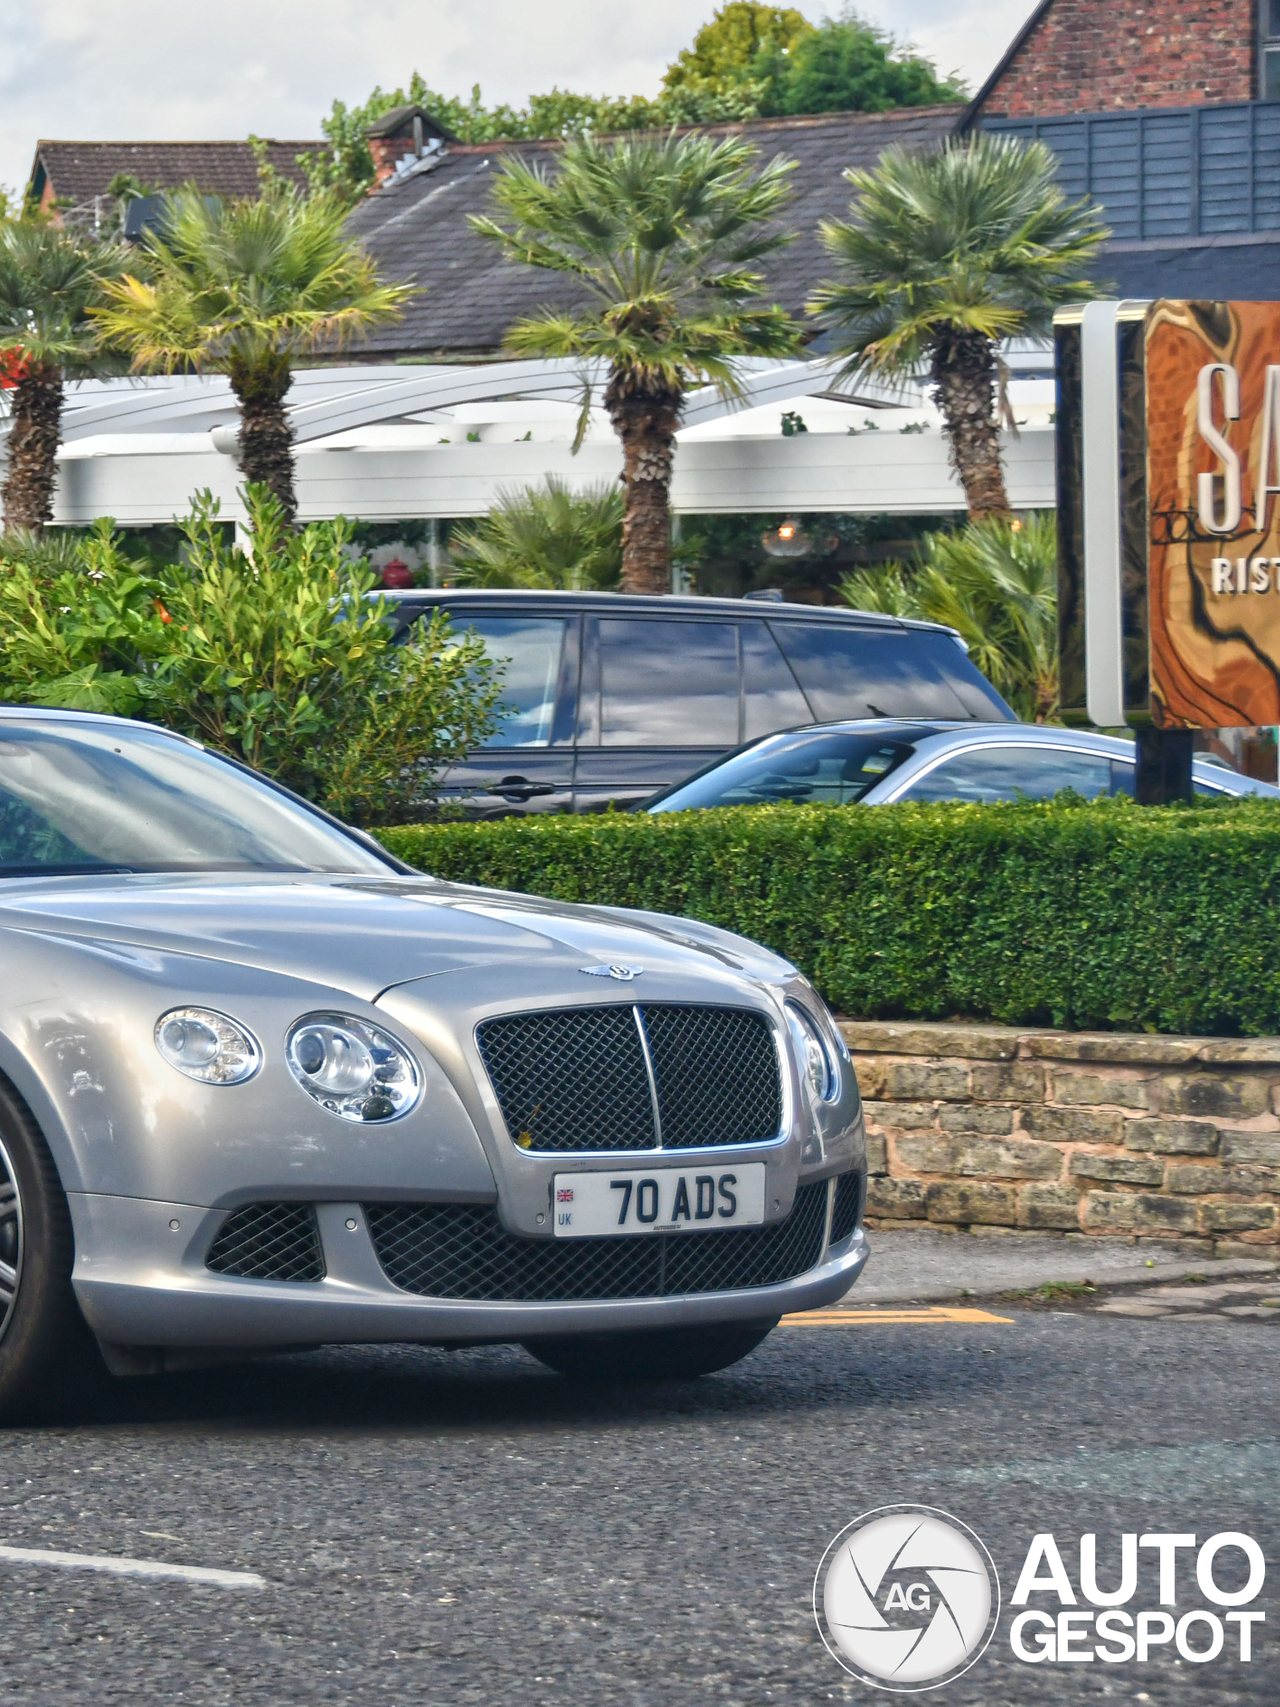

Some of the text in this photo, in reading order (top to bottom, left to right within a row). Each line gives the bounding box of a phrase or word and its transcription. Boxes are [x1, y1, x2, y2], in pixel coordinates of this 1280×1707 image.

[610, 1173, 737, 1225] 70 ADS
[558, 1213, 572, 1226] UK
